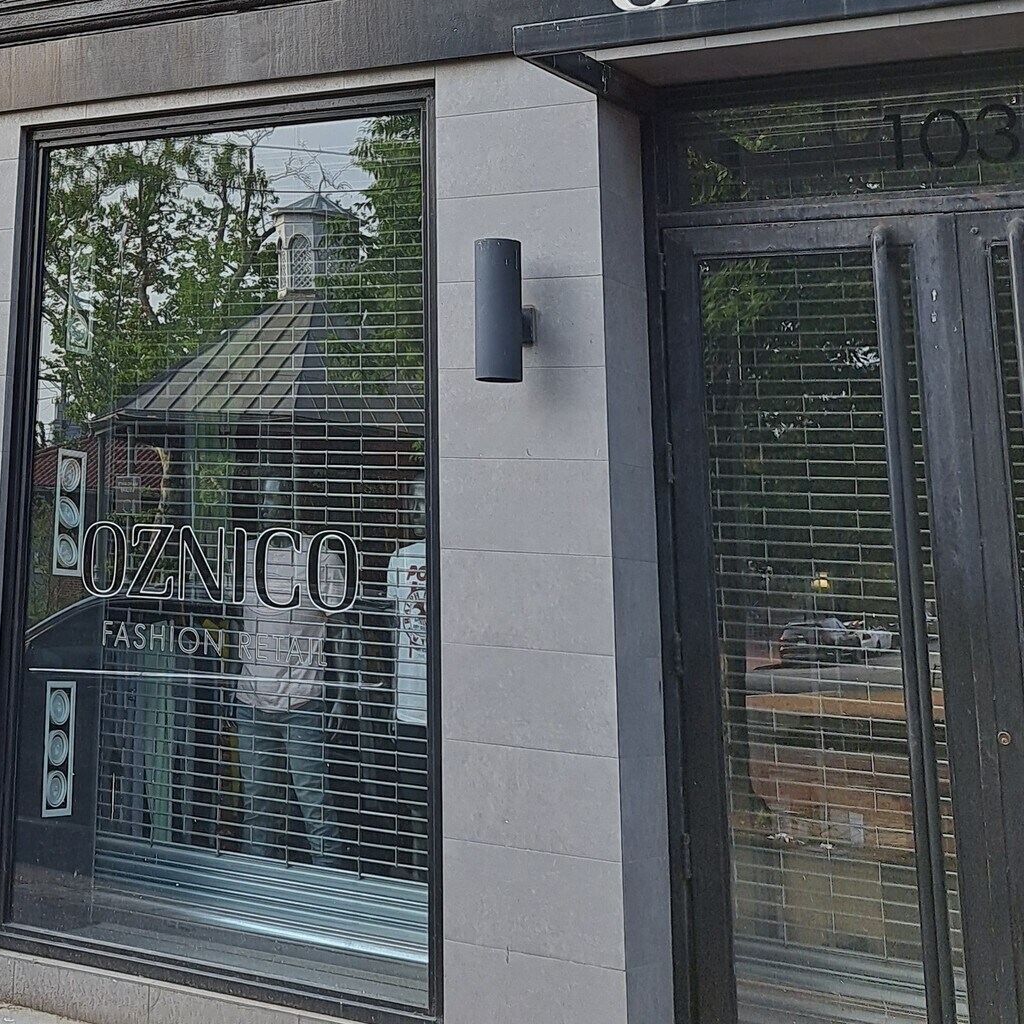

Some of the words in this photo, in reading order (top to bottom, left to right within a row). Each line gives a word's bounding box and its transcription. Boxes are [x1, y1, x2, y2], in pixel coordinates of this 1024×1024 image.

[81, 521, 360, 614] OZNICO
[102, 620, 223, 657] FASHION
[238, 631, 328, 667] RETAIL
